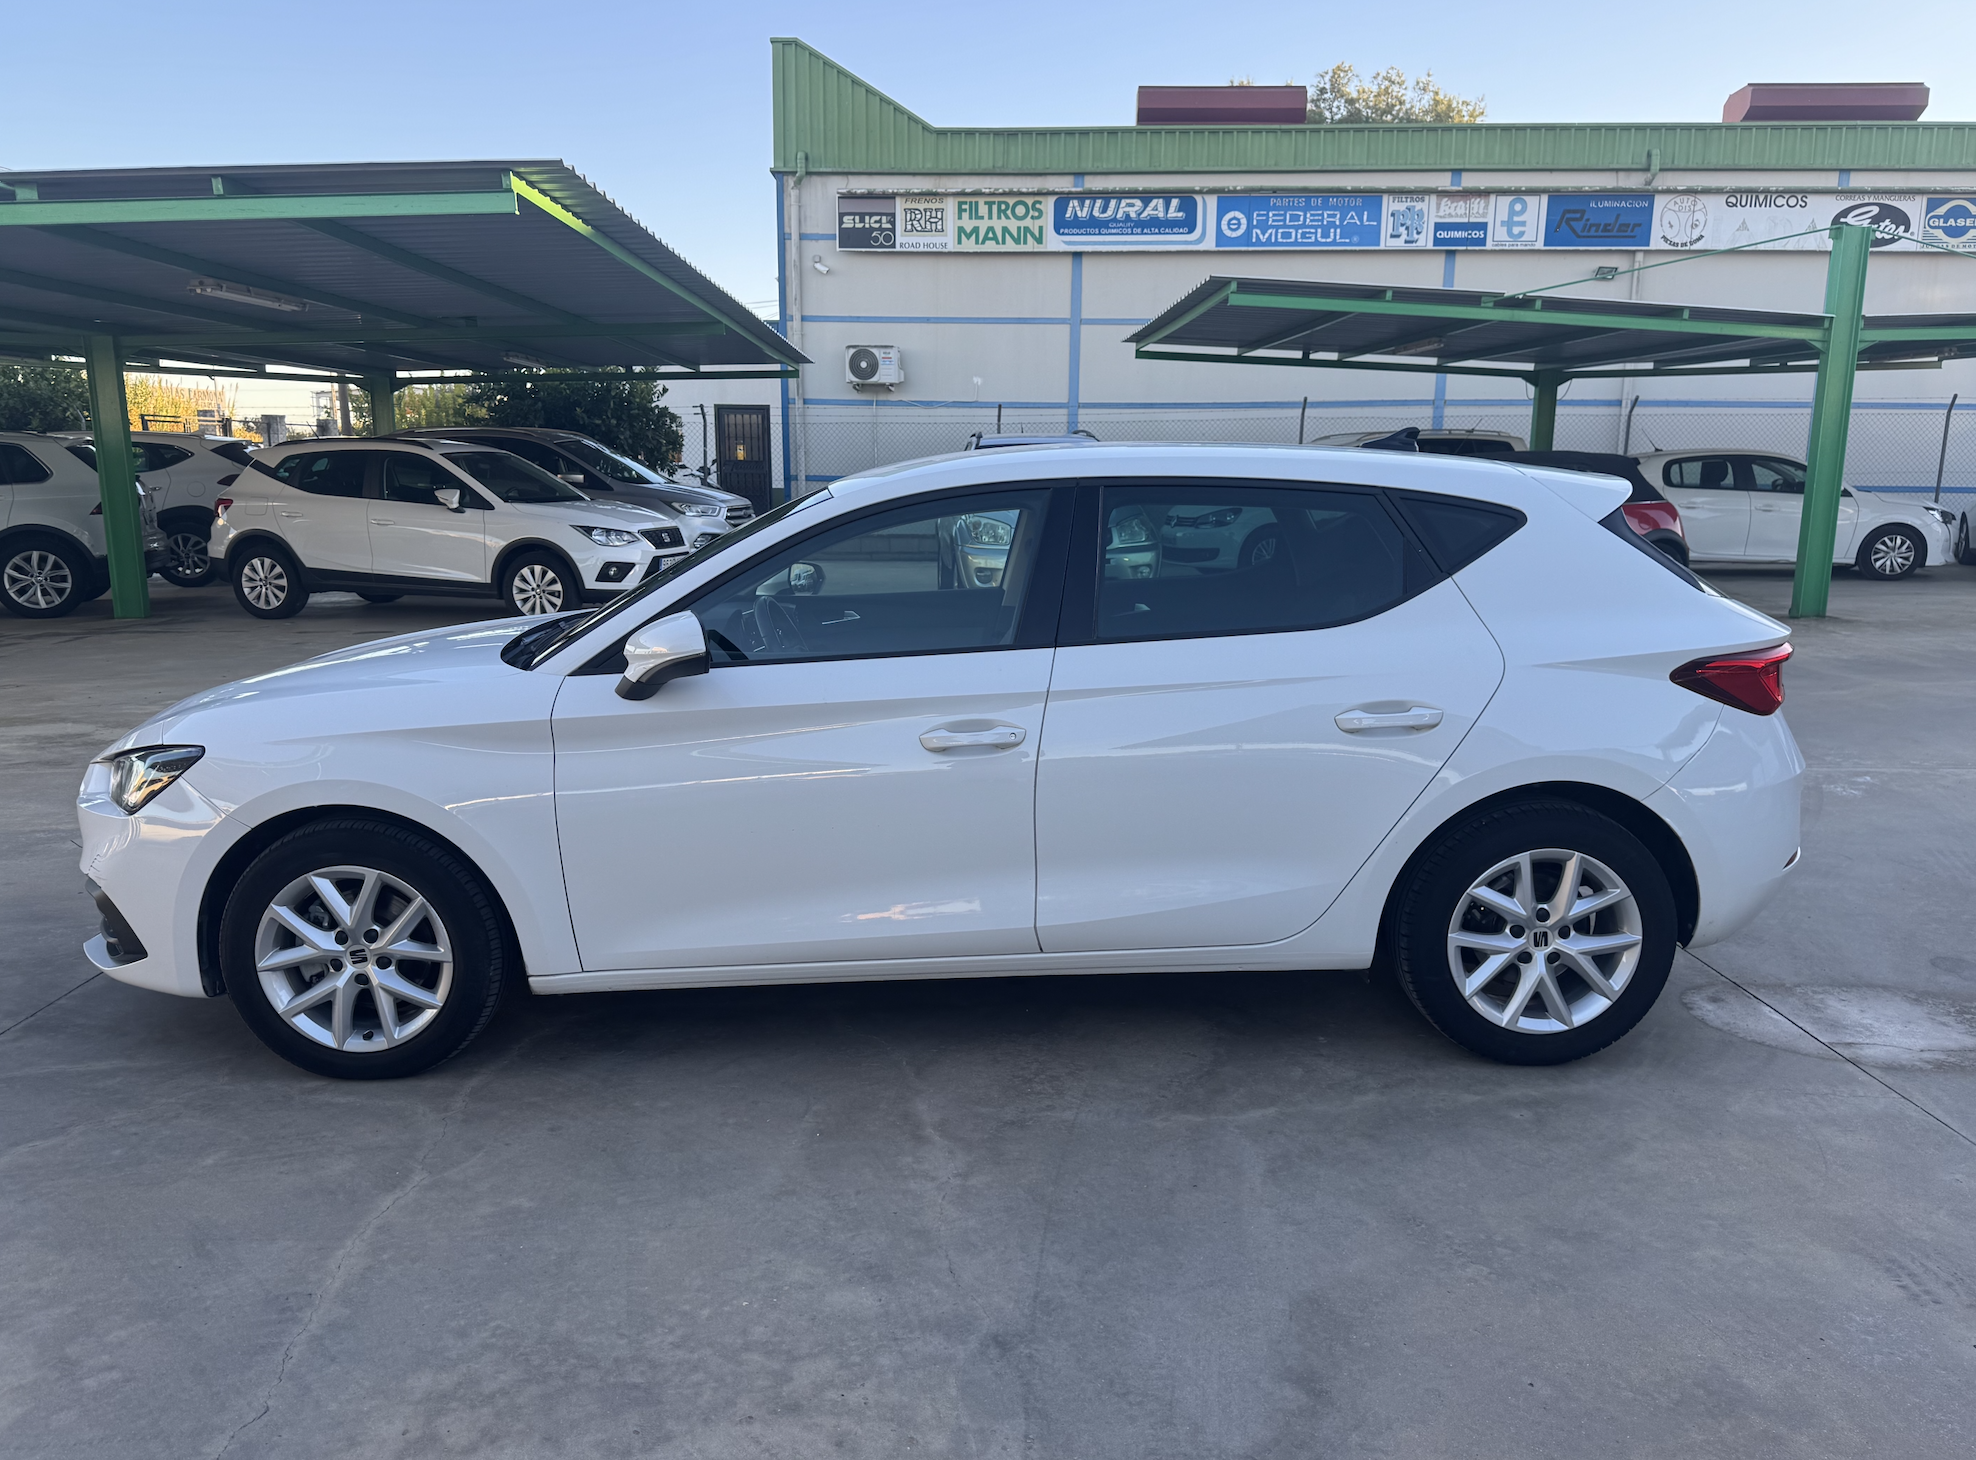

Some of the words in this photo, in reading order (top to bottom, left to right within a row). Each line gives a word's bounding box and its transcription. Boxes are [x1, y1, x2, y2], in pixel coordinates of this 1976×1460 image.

[1065, 198, 1185, 220] NURAL
[1270, 198, 1305, 207] PARTES
[1311, 198, 1322, 206] DE
[1329, 197, 1362, 206] MOTOR
[1590, 200, 1648, 208] ILUMINACION
[1673, 197, 1698, 207] AUTO
[1725, 194, 1808, 209] QUIMICOS
[957, 200, 1044, 221] FILTROS
[1253, 210, 1377, 226] FEDERAL
[904, 208, 945, 233] RH
[1554, 209, 1642, 239] Rinder
[1840, 205, 1906, 239] Gtes
[1929, 218, 1976, 227] GLASE
[870, 231, 894, 246] 50
[957, 226, 1044, 245] MANN
[1252, 228, 1350, 243] MOGUL
[1436, 230, 1485, 239] QUIMICOS
